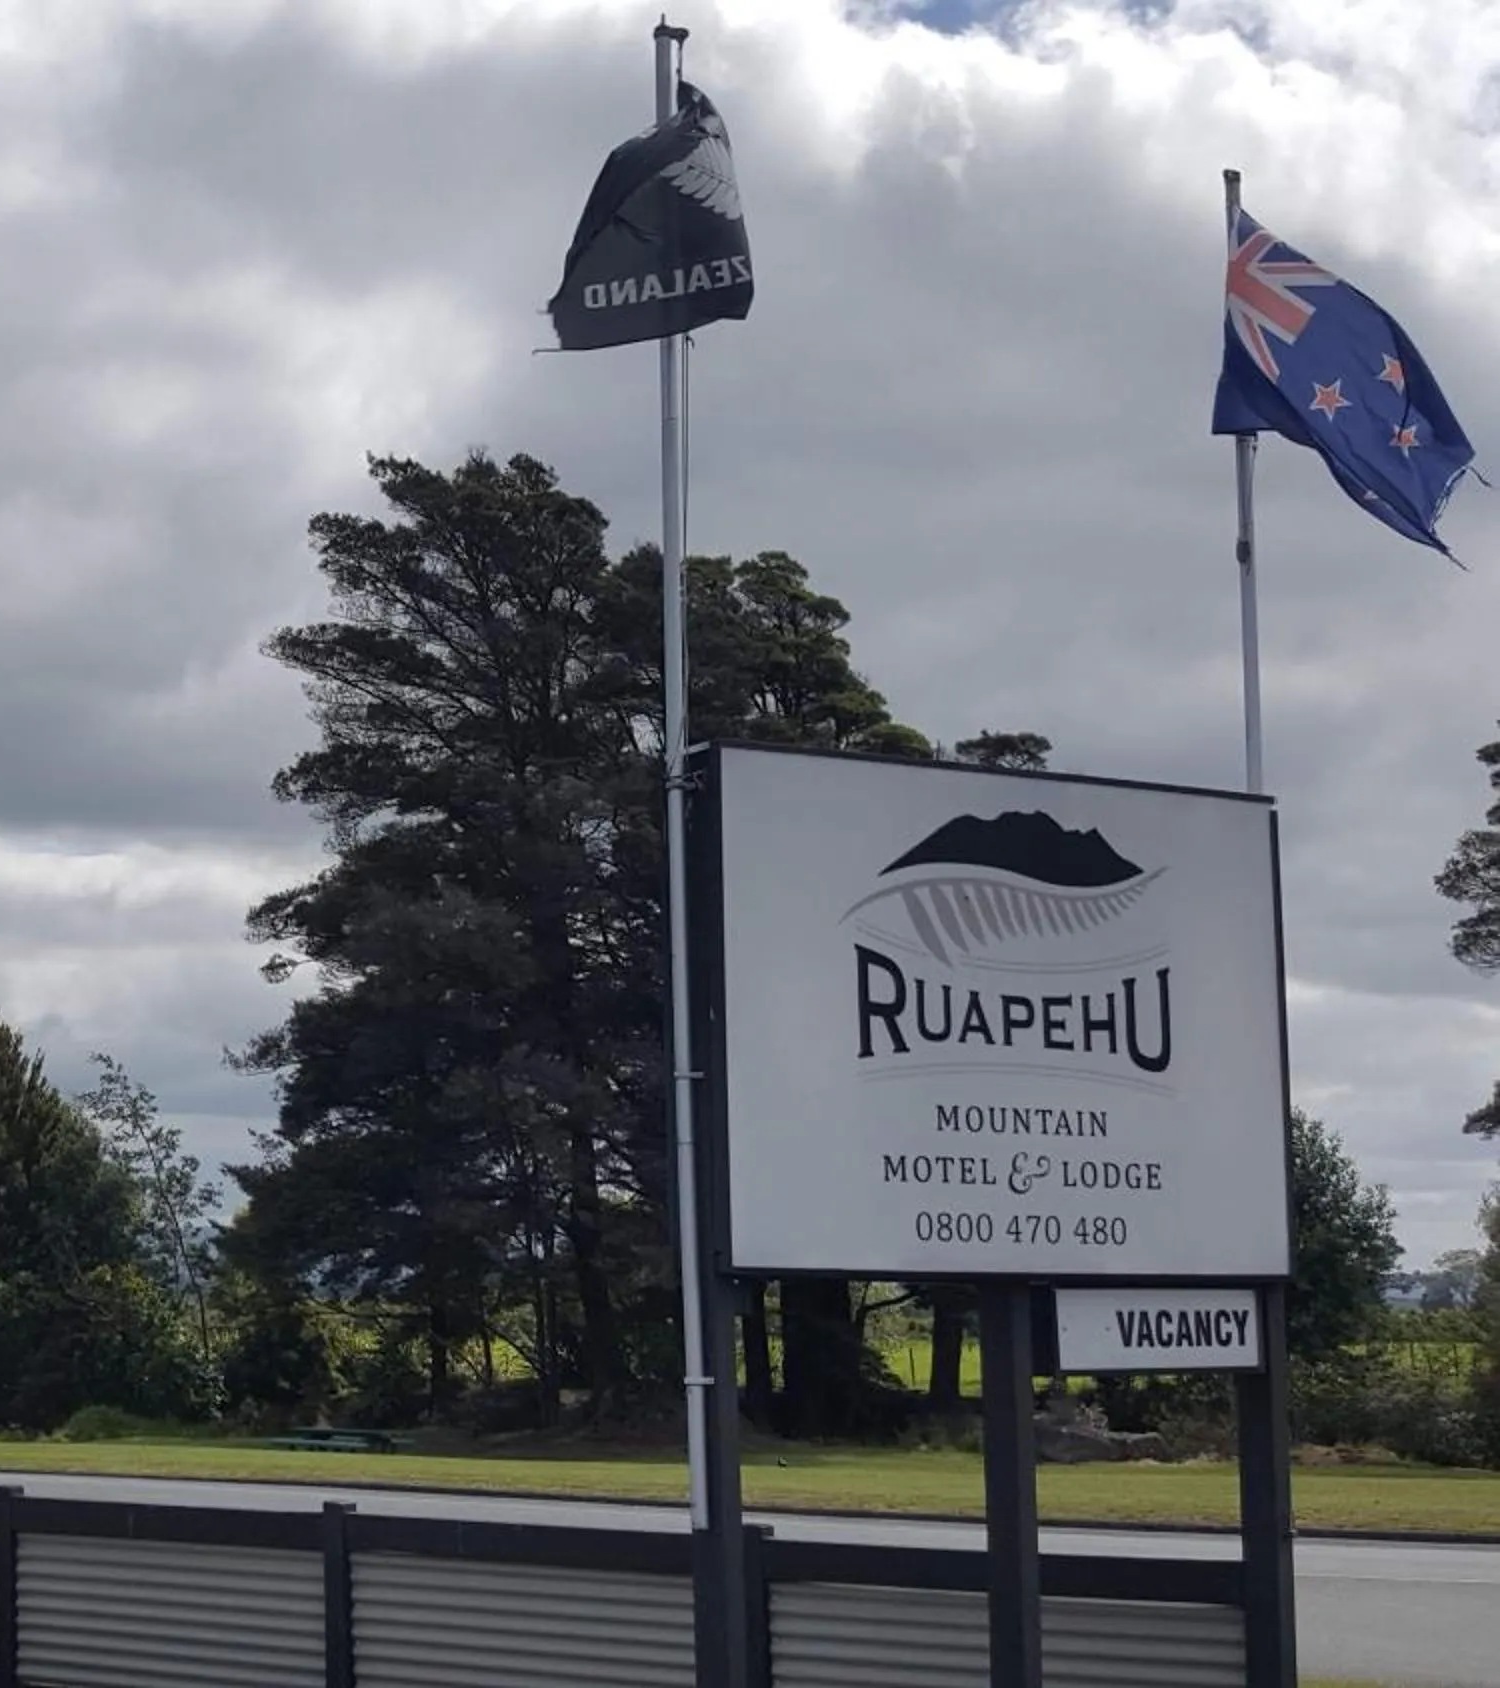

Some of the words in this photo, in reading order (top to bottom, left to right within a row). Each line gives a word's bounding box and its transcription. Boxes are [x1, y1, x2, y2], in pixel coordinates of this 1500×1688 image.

[854, 944, 1172, 1073] RUAPEHU
[935, 1104, 1109, 1138] MOUNTAIN
[883, 1154, 997, 1187] MOTEL
[1007, 1152, 1051, 1194] &
[1061, 1161, 1162, 1191] LODGE
[915, 1211, 994, 1243] 0800
[1006, 1214, 1061, 1244] 470
[1073, 1216, 1128, 1247] 480
[1116, 1309, 1249, 1348] VACANCY
